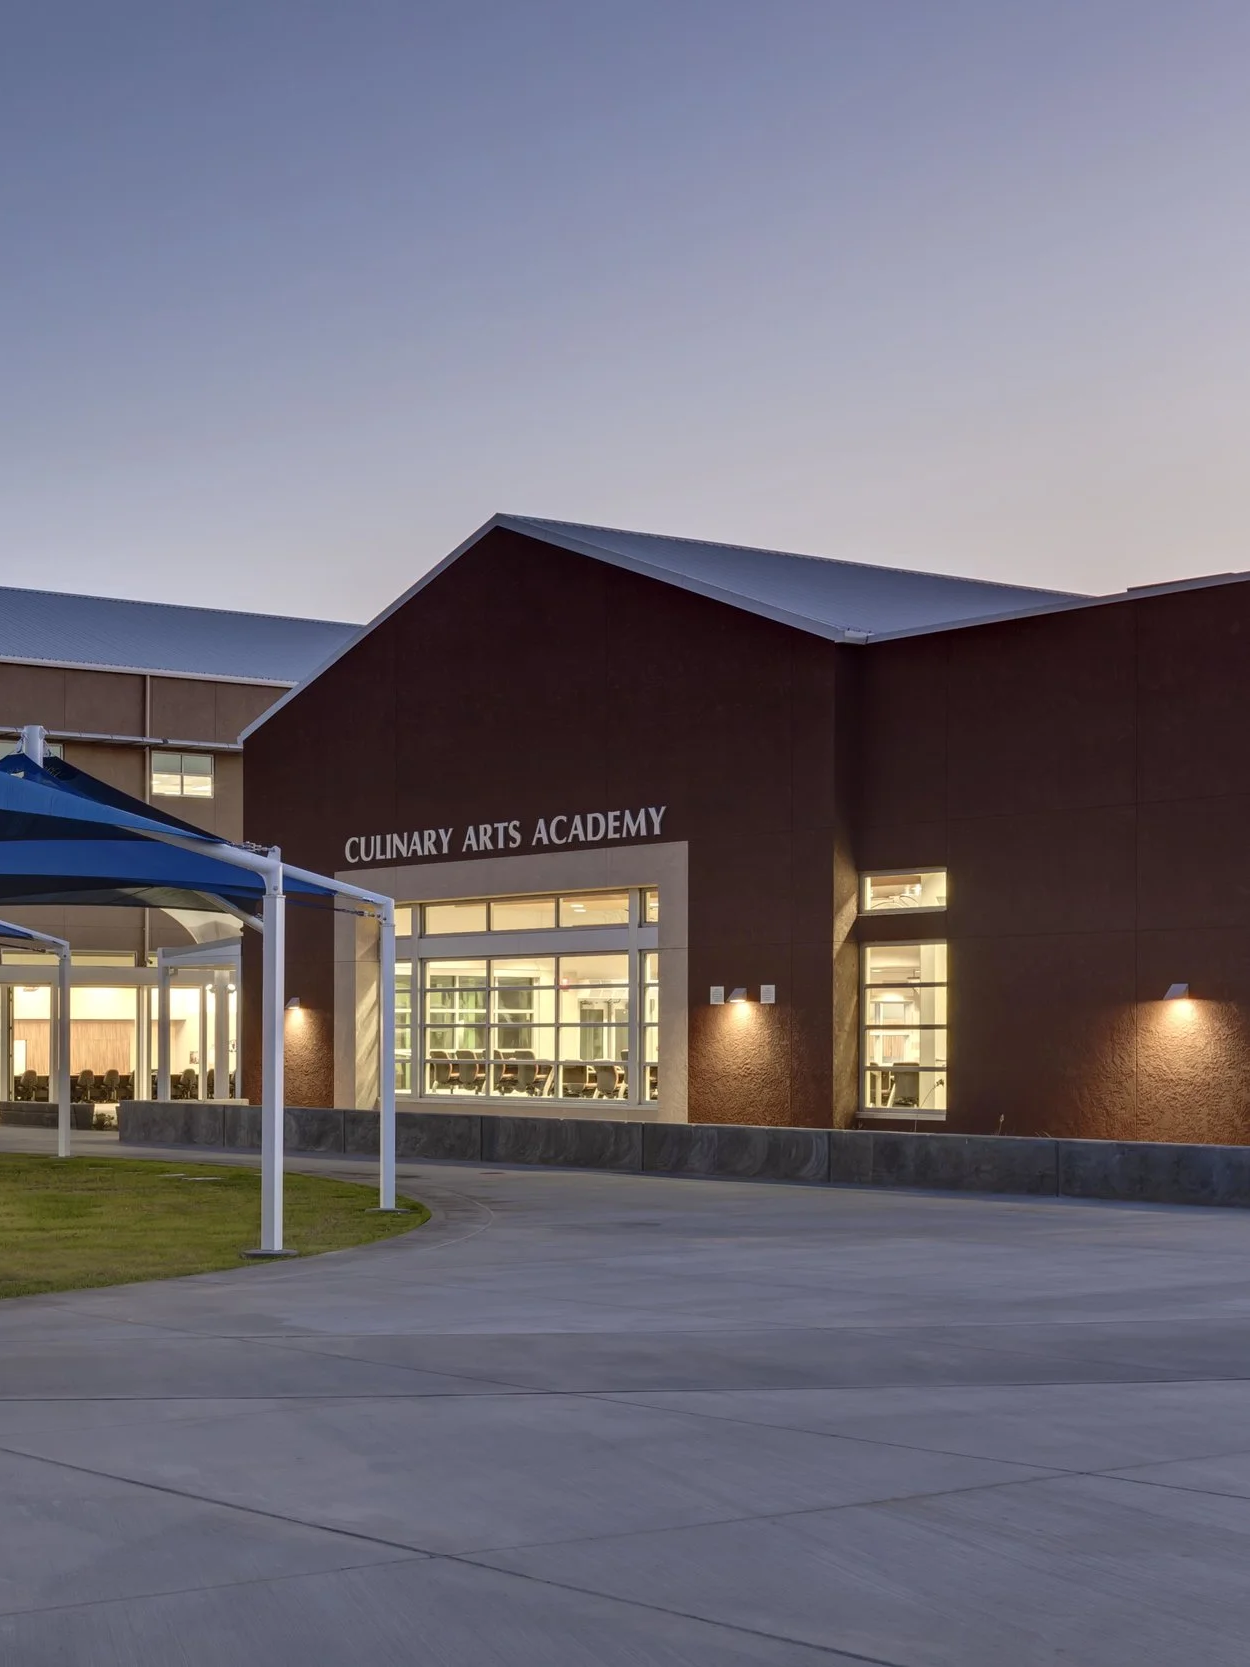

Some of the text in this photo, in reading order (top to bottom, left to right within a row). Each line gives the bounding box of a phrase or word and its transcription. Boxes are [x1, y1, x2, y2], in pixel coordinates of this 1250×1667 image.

[344, 805, 667, 863] CULINARY ARTS ACADEMY
